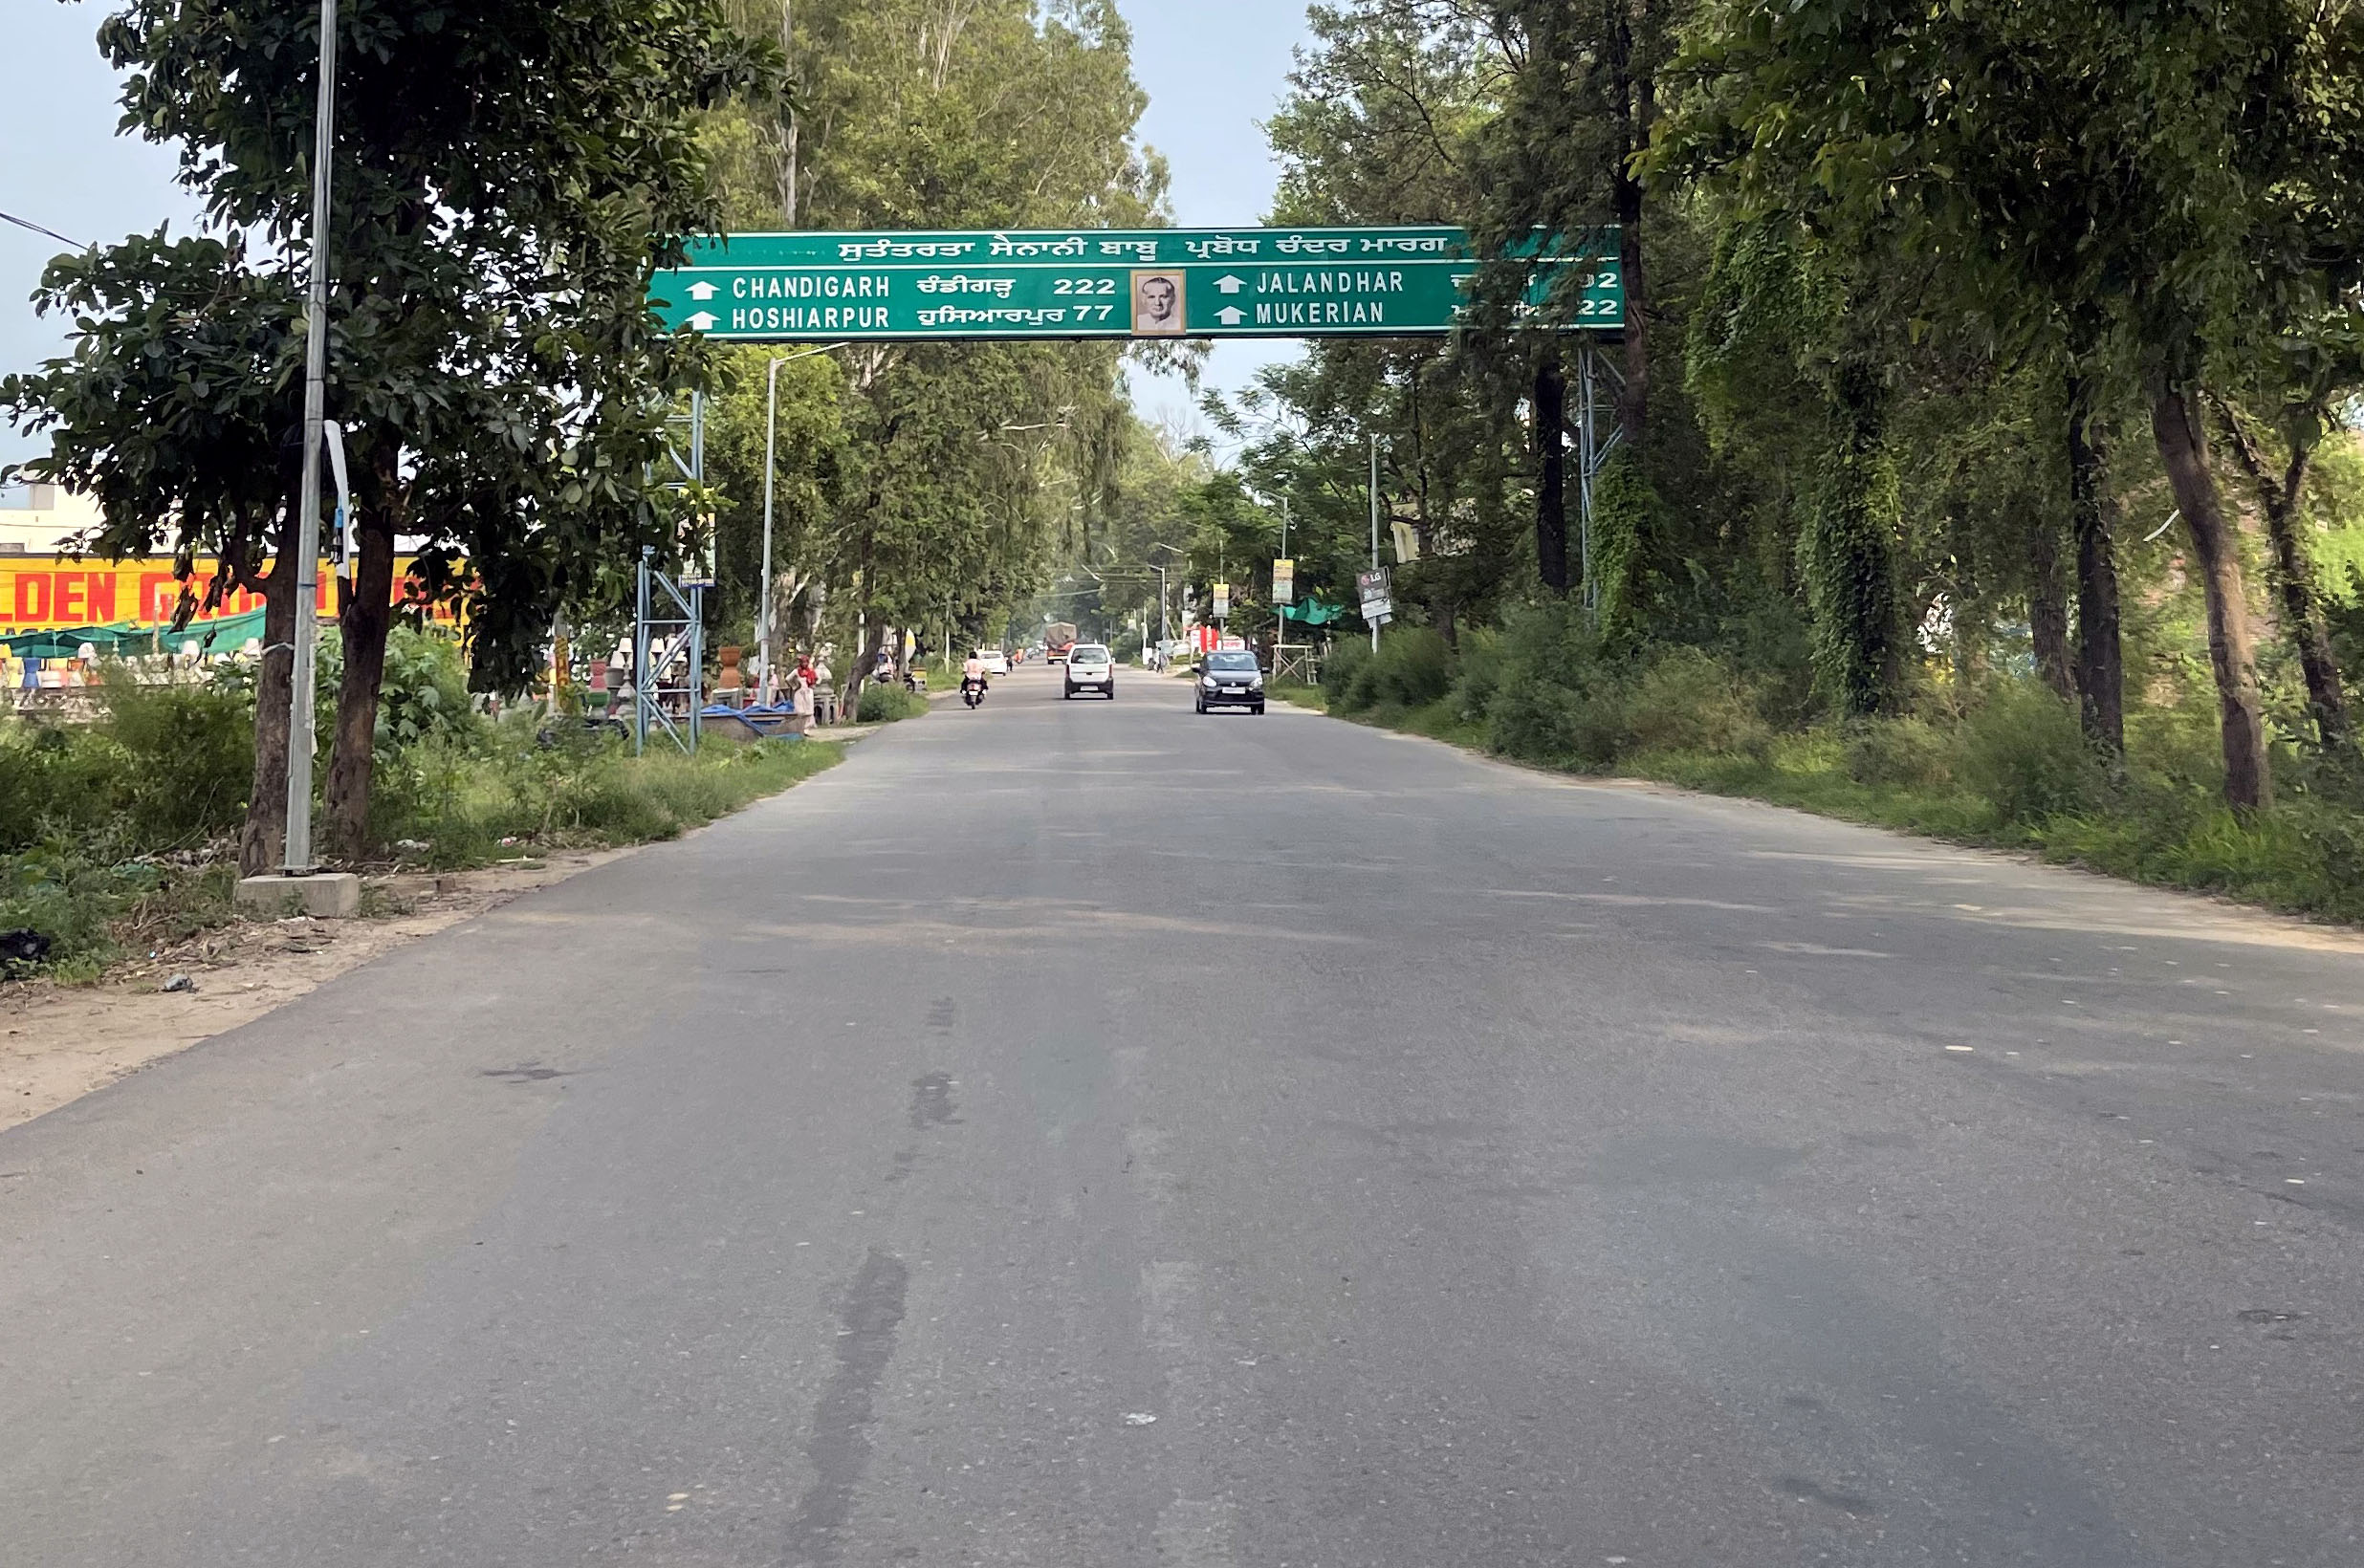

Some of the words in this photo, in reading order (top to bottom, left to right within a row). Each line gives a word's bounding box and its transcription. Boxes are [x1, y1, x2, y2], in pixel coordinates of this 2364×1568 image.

[838, 239, 975, 262] ਸੁਤੰਤਰਤਾ
[989, 234, 1088, 256] ਸੈਨਾਨੀ
[1099, 241, 1158, 262] ਬਾਬੂ
[1185, 235, 1260, 259] ਪ੍ਰਬੋਧ
[1276, 235, 1350, 253] ਚੰਦਰ
[1361, 237, 1448, 252] ਮਾਰਗ
[733, 275, 889, 298] CHANDIGARH
[916, 275, 1017, 298] ਚੰਡੀਗੜ੍ਹ
[1053, 278, 1116, 294] 222
[1257, 272, 1403, 294] JALANDHAR
[733, 307, 889, 329] HOSHIARPUR
[916, 305, 1066, 326] ਹੁਸਿਆਰਪੁਰ
[1072, 305, 1114, 321] 77
[1256, 301, 1384, 324] MUKERIAN
[1369, 572, 1382, 583] LG
